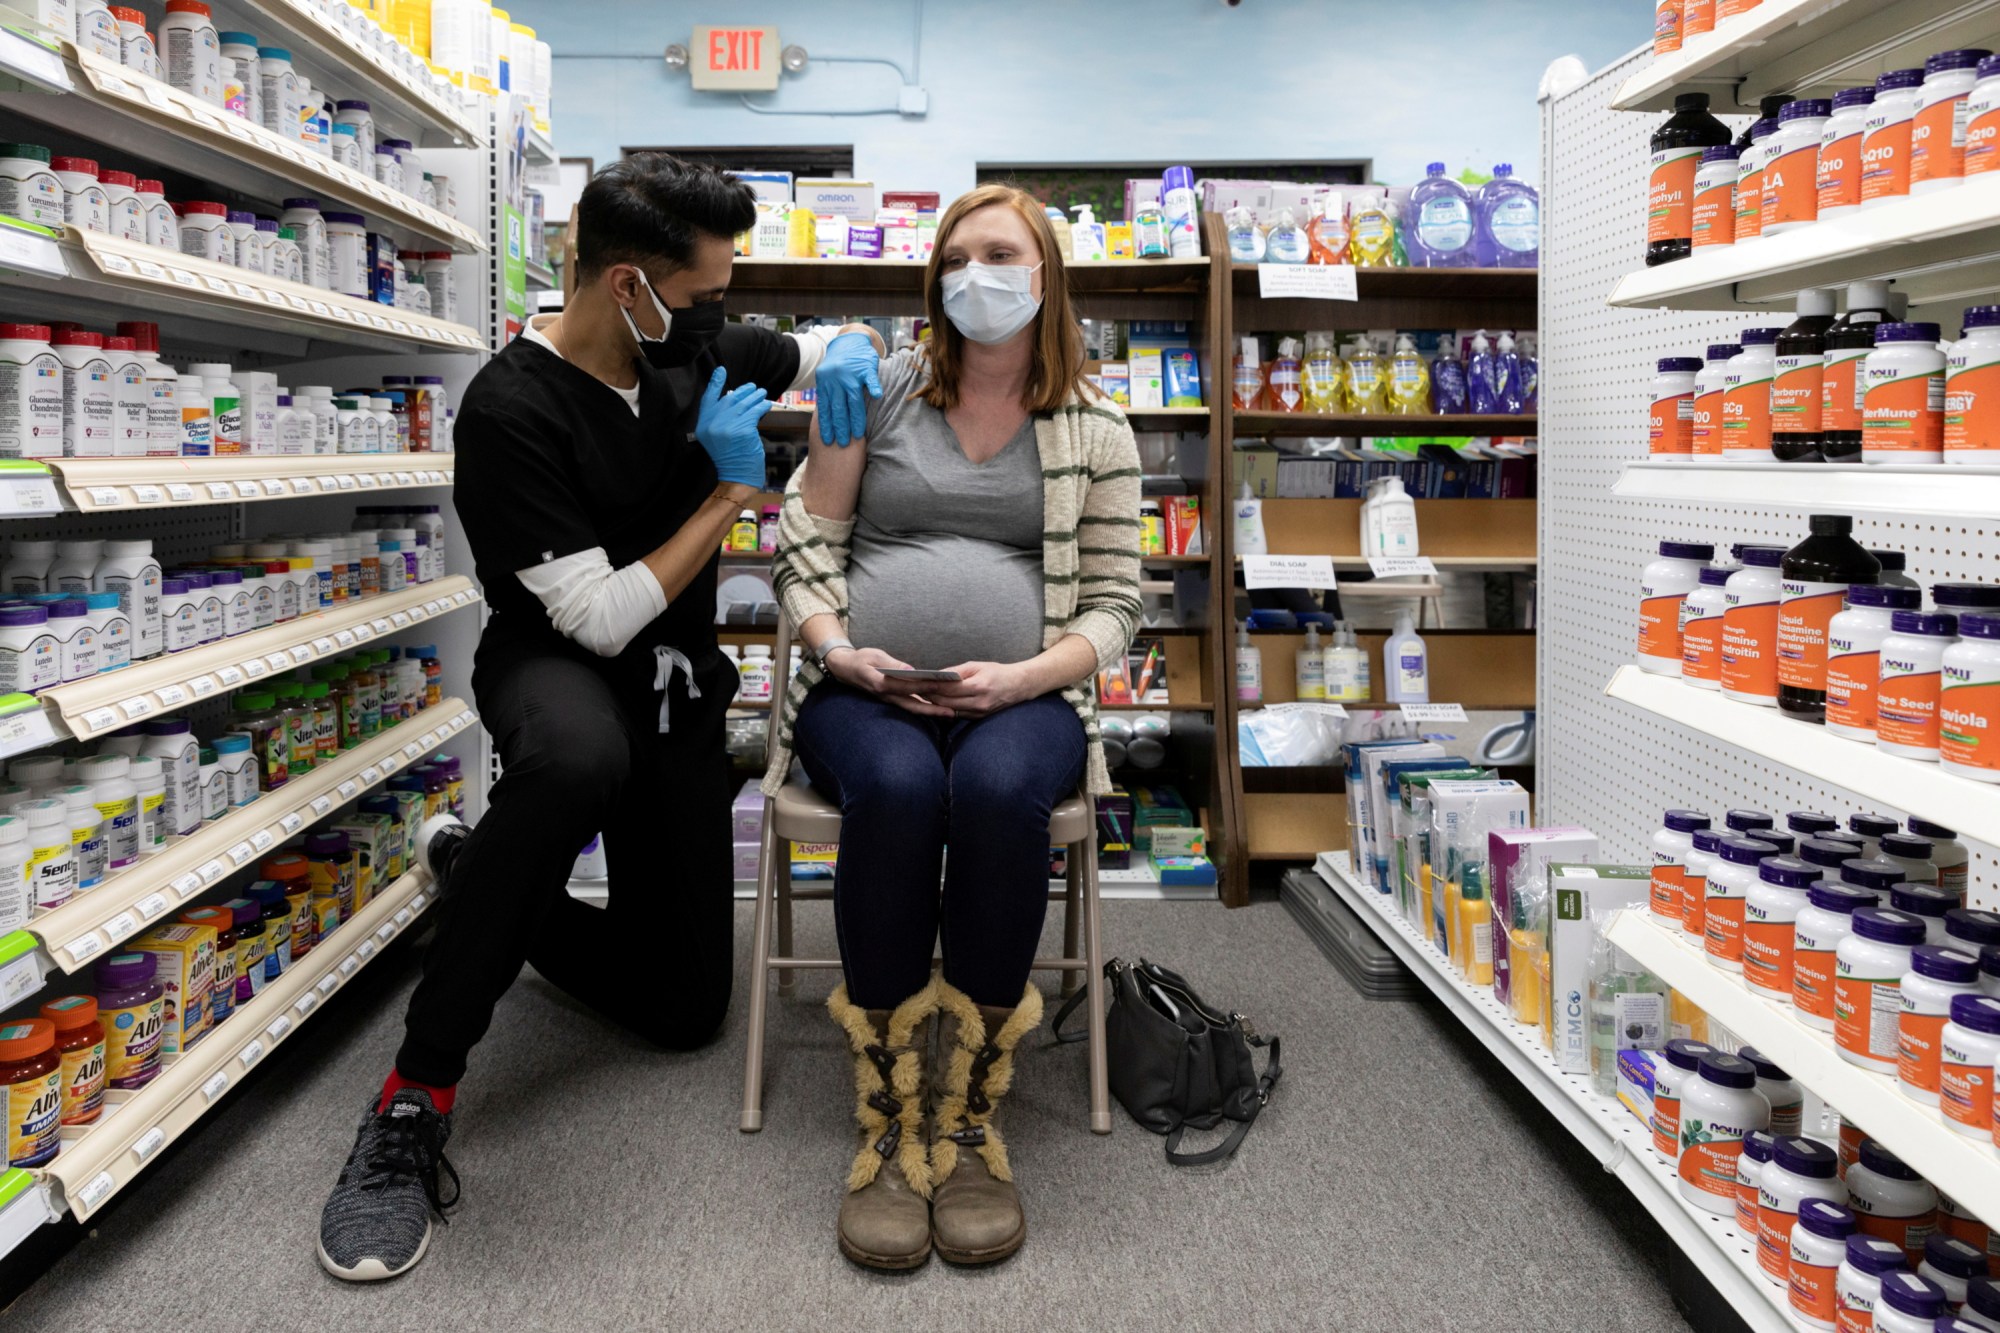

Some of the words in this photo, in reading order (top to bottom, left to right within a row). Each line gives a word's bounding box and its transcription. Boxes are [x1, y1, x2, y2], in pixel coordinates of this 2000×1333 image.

[708, 30, 764, 71] EXIT
[27, 195, 57, 209] Curcumin
[851, 231, 878, 242] Systane
[30, 403, 62, 413] Chondroitin
[84, 406, 113, 416] Chondroitin
[1170, 503, 1178, 556] ThermaCare
[144, 605, 159, 616] Multi
[176, 623, 196, 633] Melatonin
[102, 638, 130, 650] Magnesium
[73, 648, 96, 661] Lycopene
[34, 656, 53, 668] Lutein
[743, 674, 767, 683] Sentry
[1899, 697, 1935, 711] Seed
[1628, 1061, 1649, 1086] Comfort
[393, 1102, 421, 1113] adidas
[1710, 1122, 1744, 1138] now
[1713, 1159, 1736, 1171] Caps
